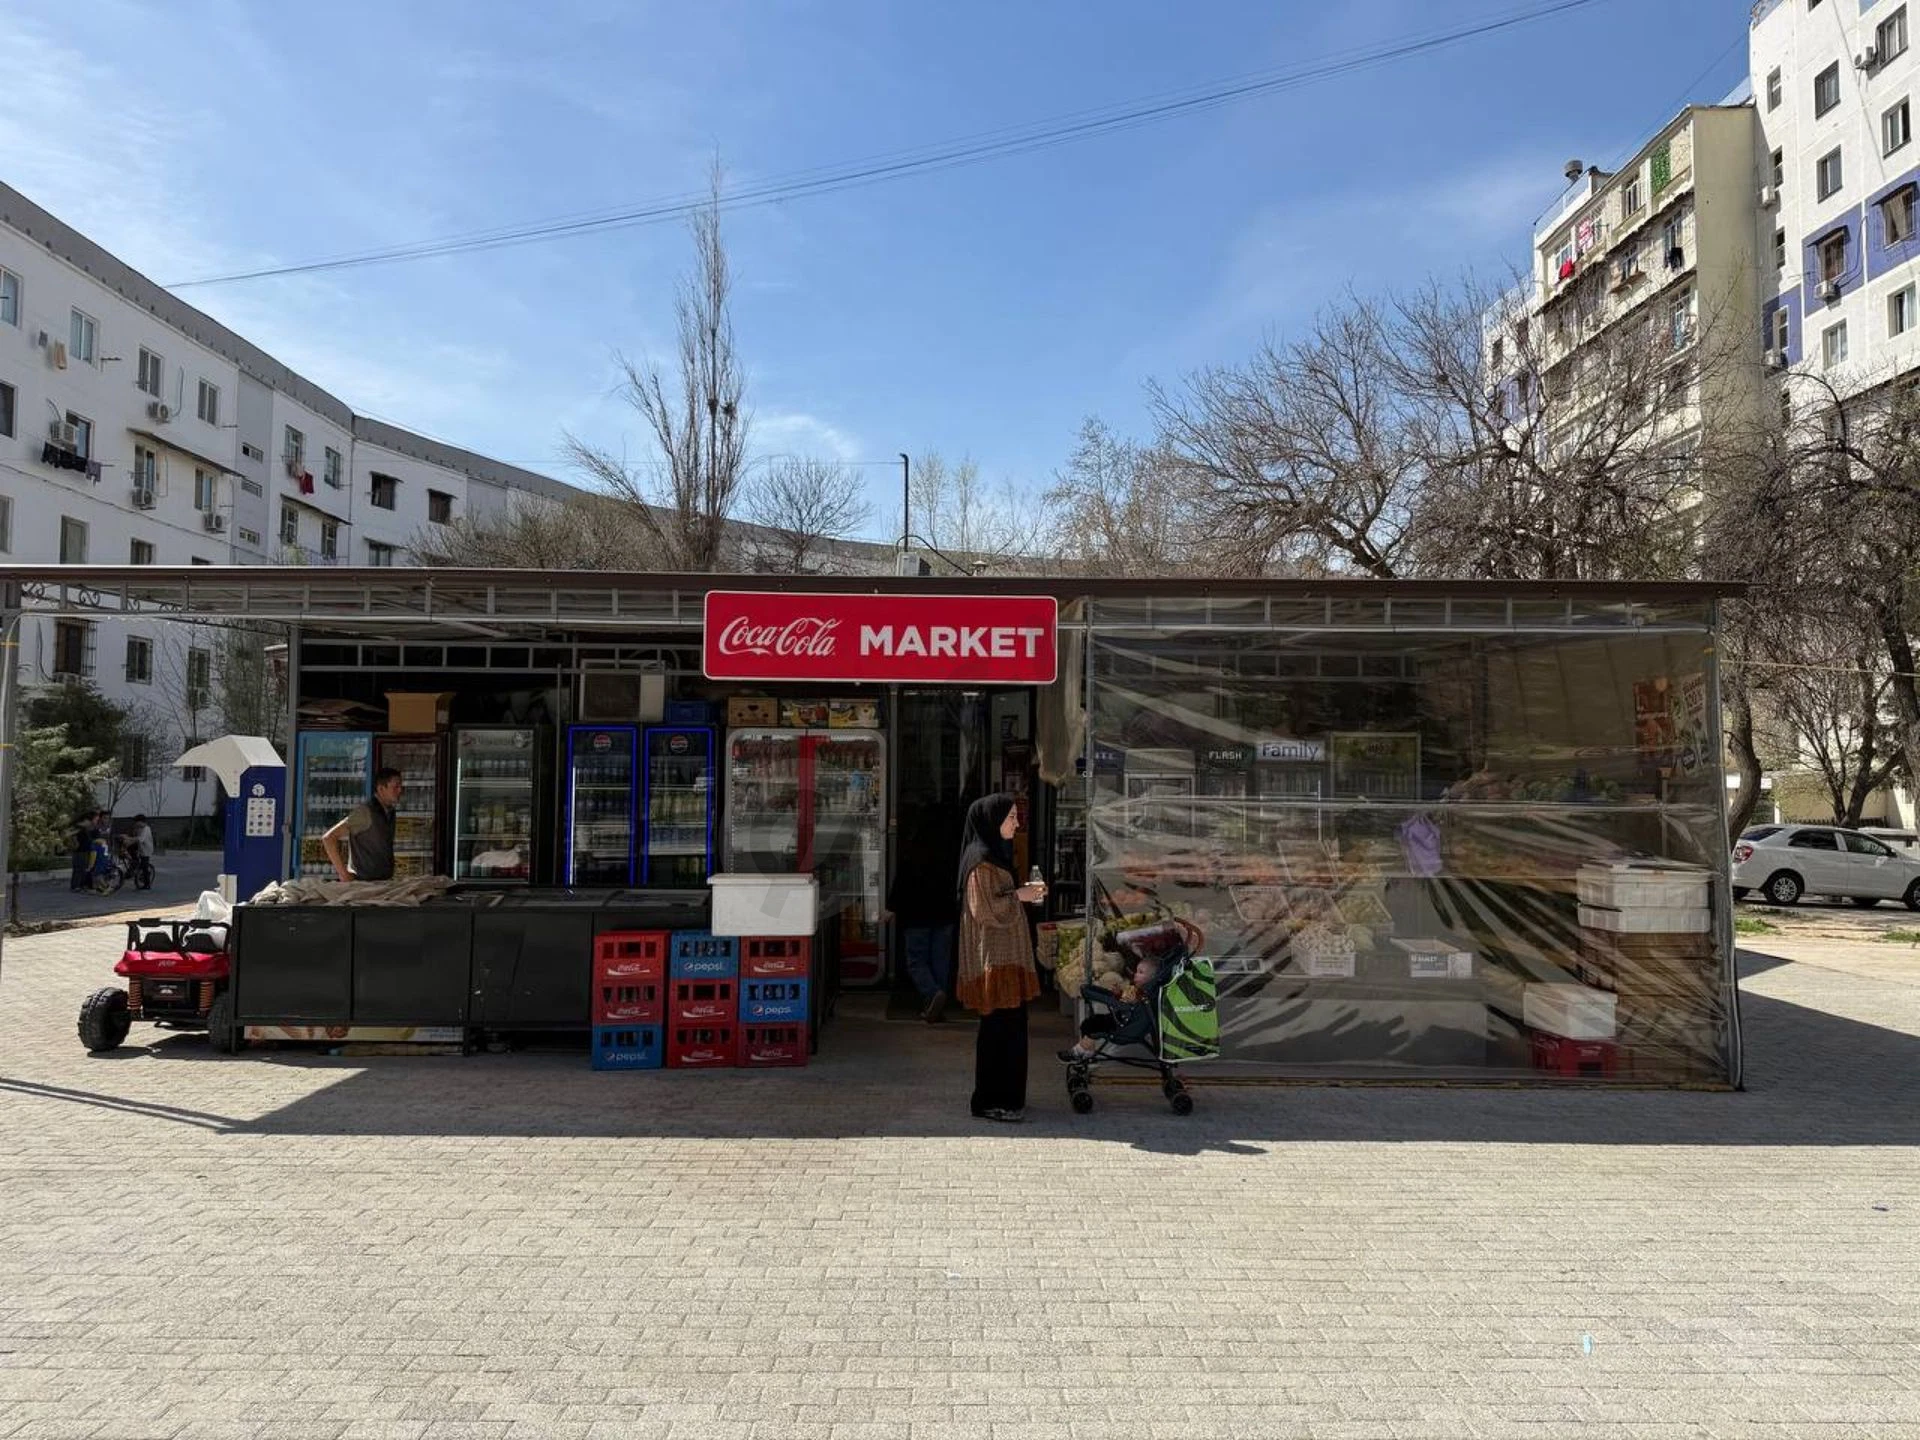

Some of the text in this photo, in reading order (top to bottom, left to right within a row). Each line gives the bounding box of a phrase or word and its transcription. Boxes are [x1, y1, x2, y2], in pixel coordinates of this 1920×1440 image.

[719, 616, 1044, 658] Coca-Cola MARKET
[1262, 741, 1319, 763] Family
